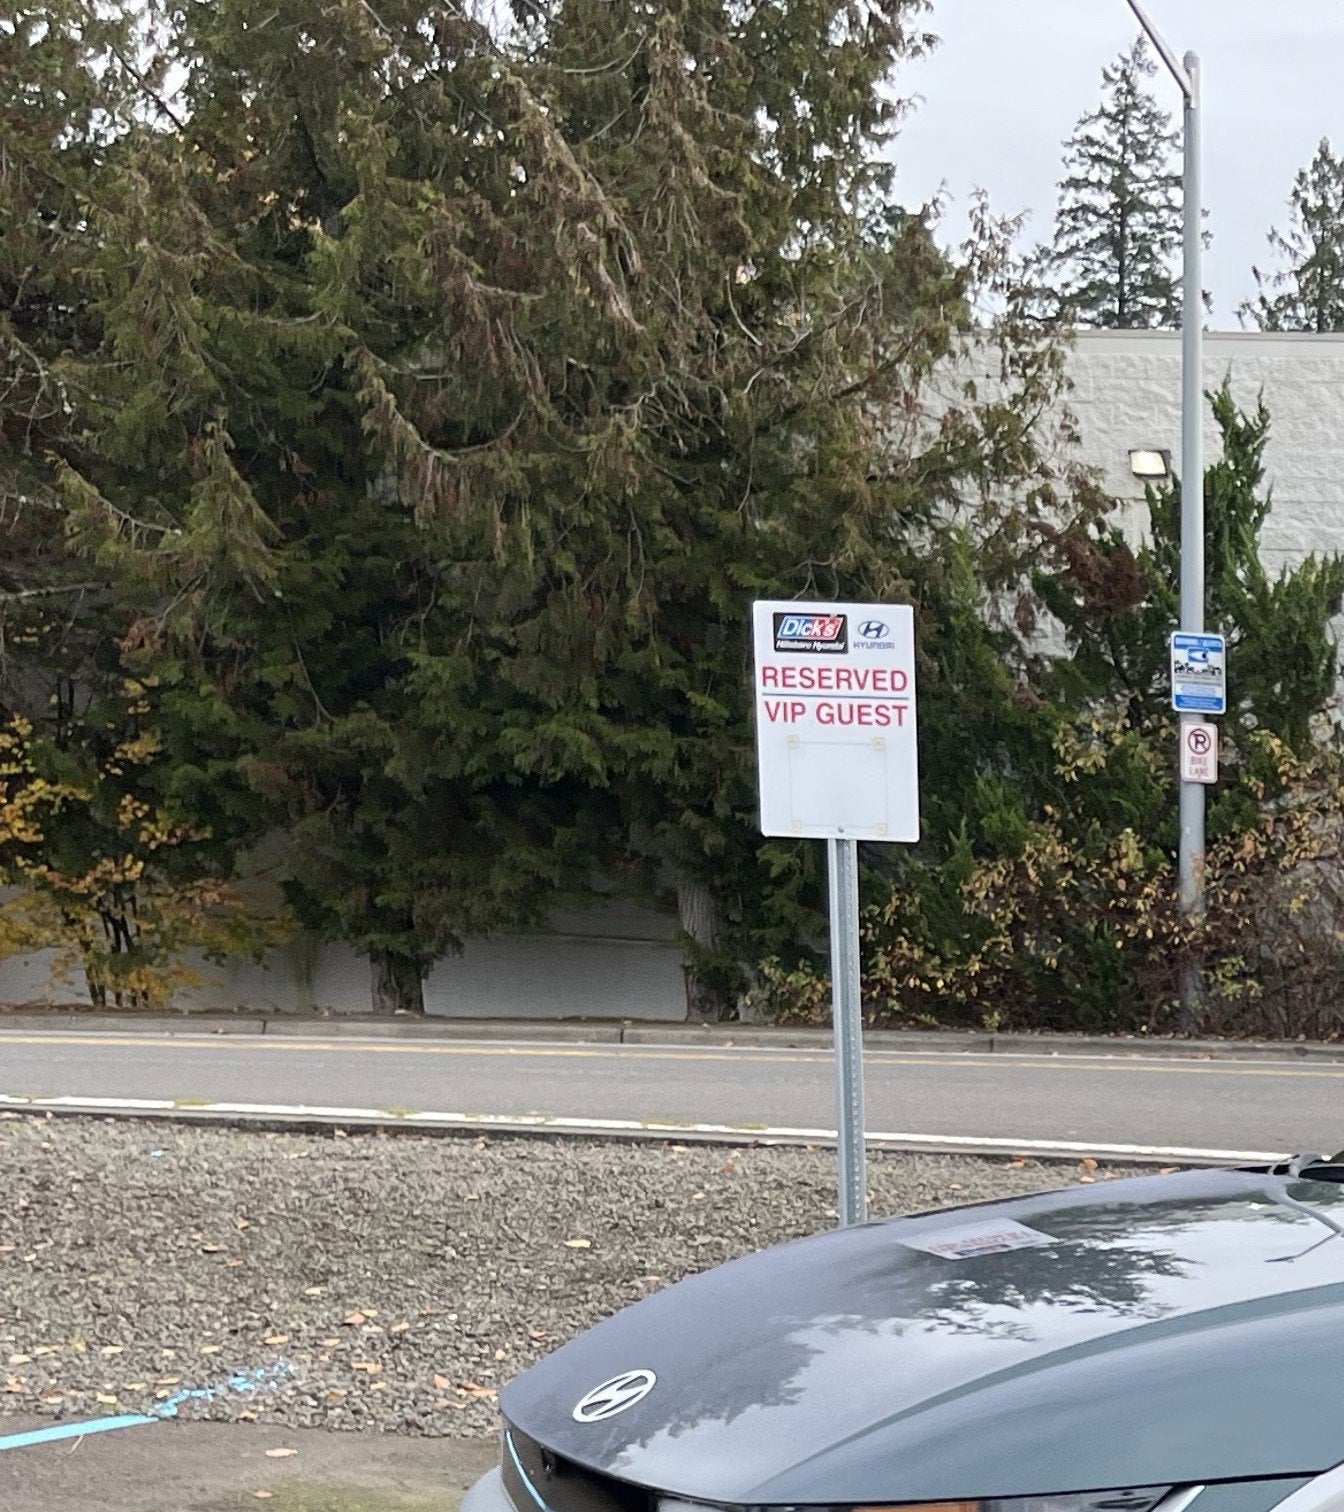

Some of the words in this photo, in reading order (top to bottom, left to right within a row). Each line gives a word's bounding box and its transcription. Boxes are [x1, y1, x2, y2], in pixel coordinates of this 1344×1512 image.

[761, 665, 908, 692] RESERVED
[763, 701, 807, 724] VIP
[815, 702, 909, 727] GUEST
